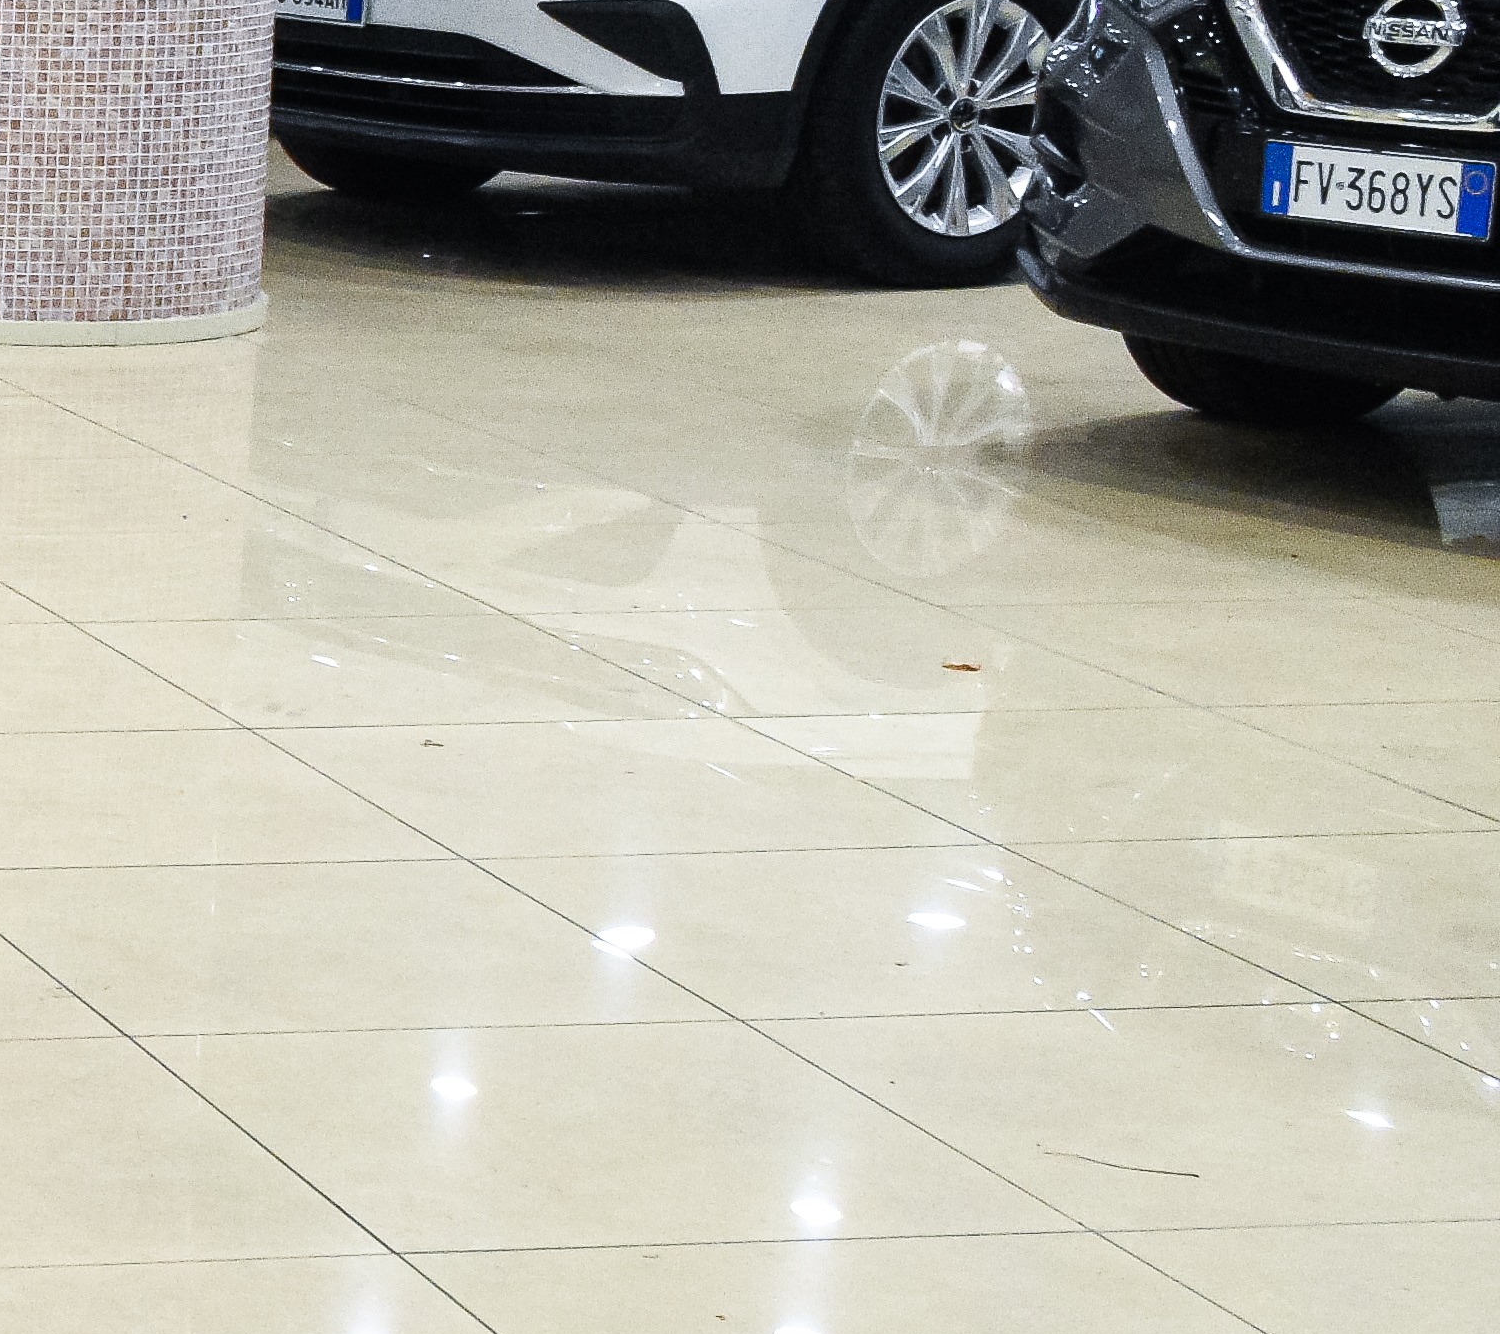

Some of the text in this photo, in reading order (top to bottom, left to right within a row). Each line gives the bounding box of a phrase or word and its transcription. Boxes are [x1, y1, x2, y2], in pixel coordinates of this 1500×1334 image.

[1370, 21, 1451, 42] NISSAN
[1292, 160, 1336, 205] FV
[1344, 167, 1459, 220] 368YS
